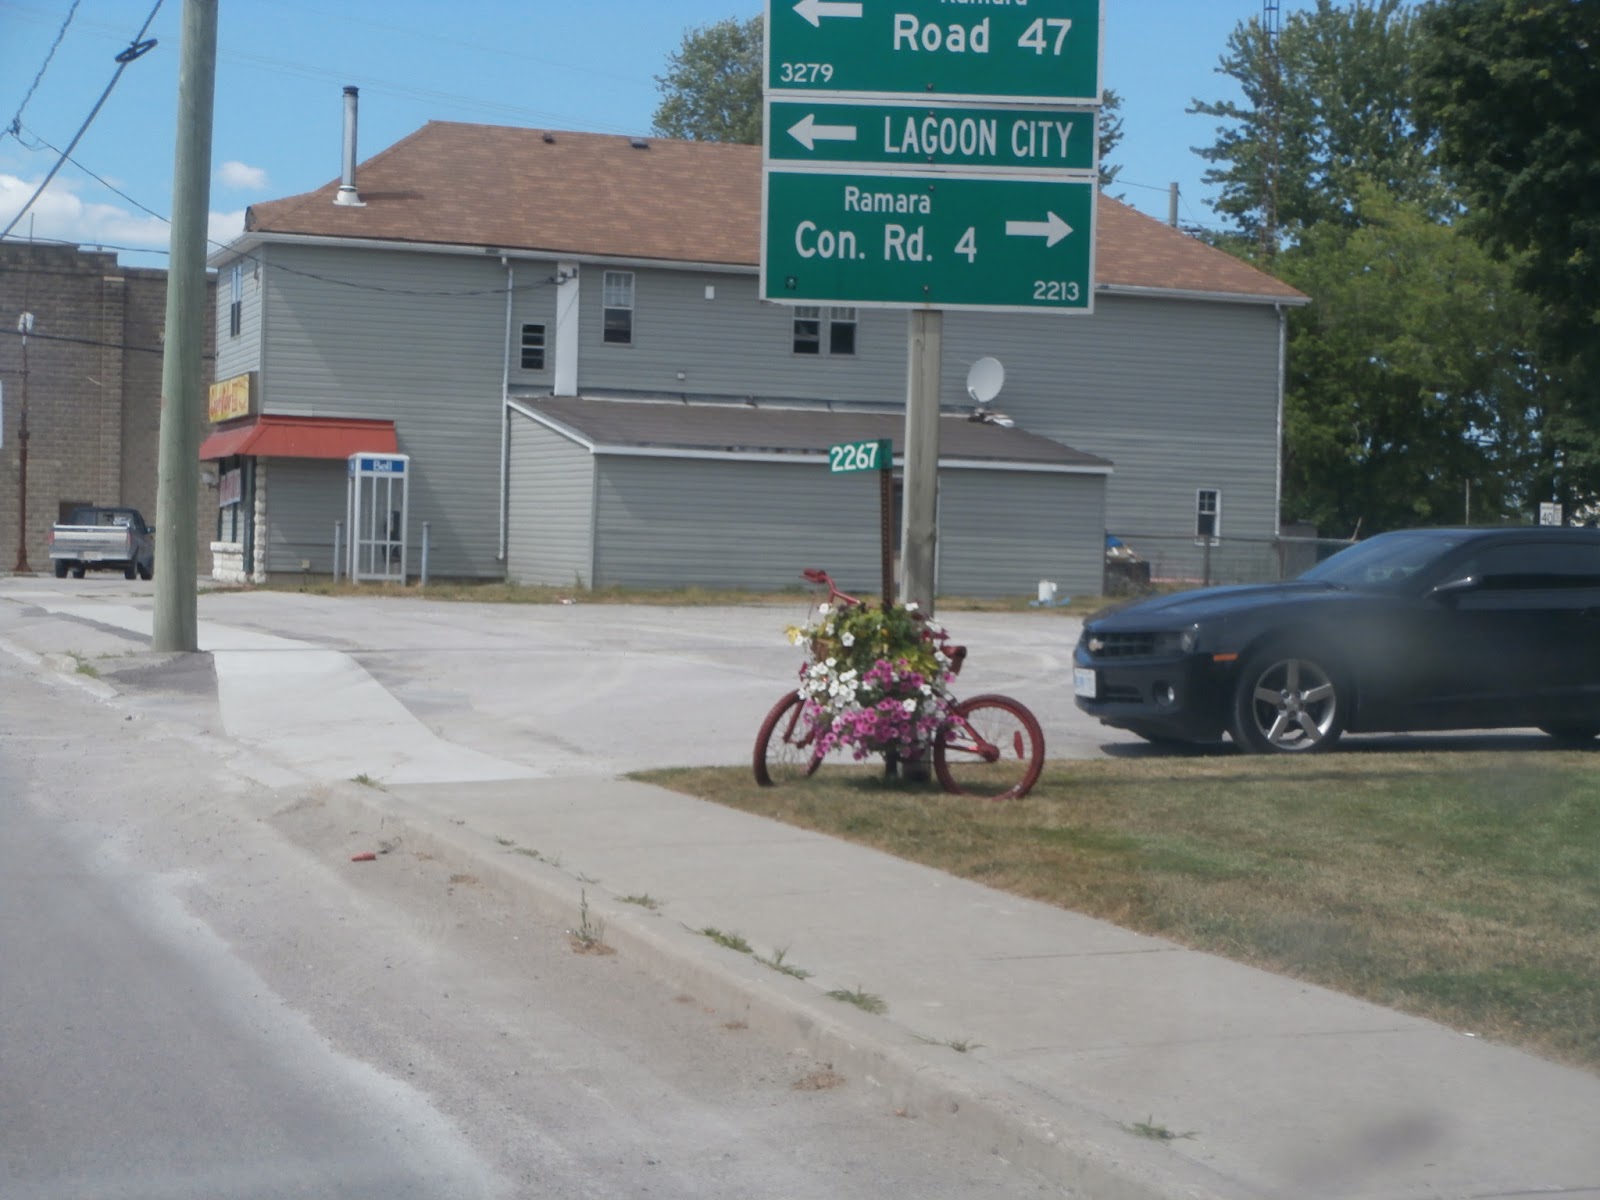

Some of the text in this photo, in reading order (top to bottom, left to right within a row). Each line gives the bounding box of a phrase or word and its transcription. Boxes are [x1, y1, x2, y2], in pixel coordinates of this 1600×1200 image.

[894, 14, 1071, 55] Road 47
[781, 63, 833, 82] 3279
[885, 116, 1072, 157] LAGOON CITY
[845, 186, 930, 213] Ramara
[796, 221, 976, 262] Con. Rd. 4
[1034, 281, 1078, 300] 2213
[373, 460, 392, 471] Bell
[831, 442, 878, 472] 2267
